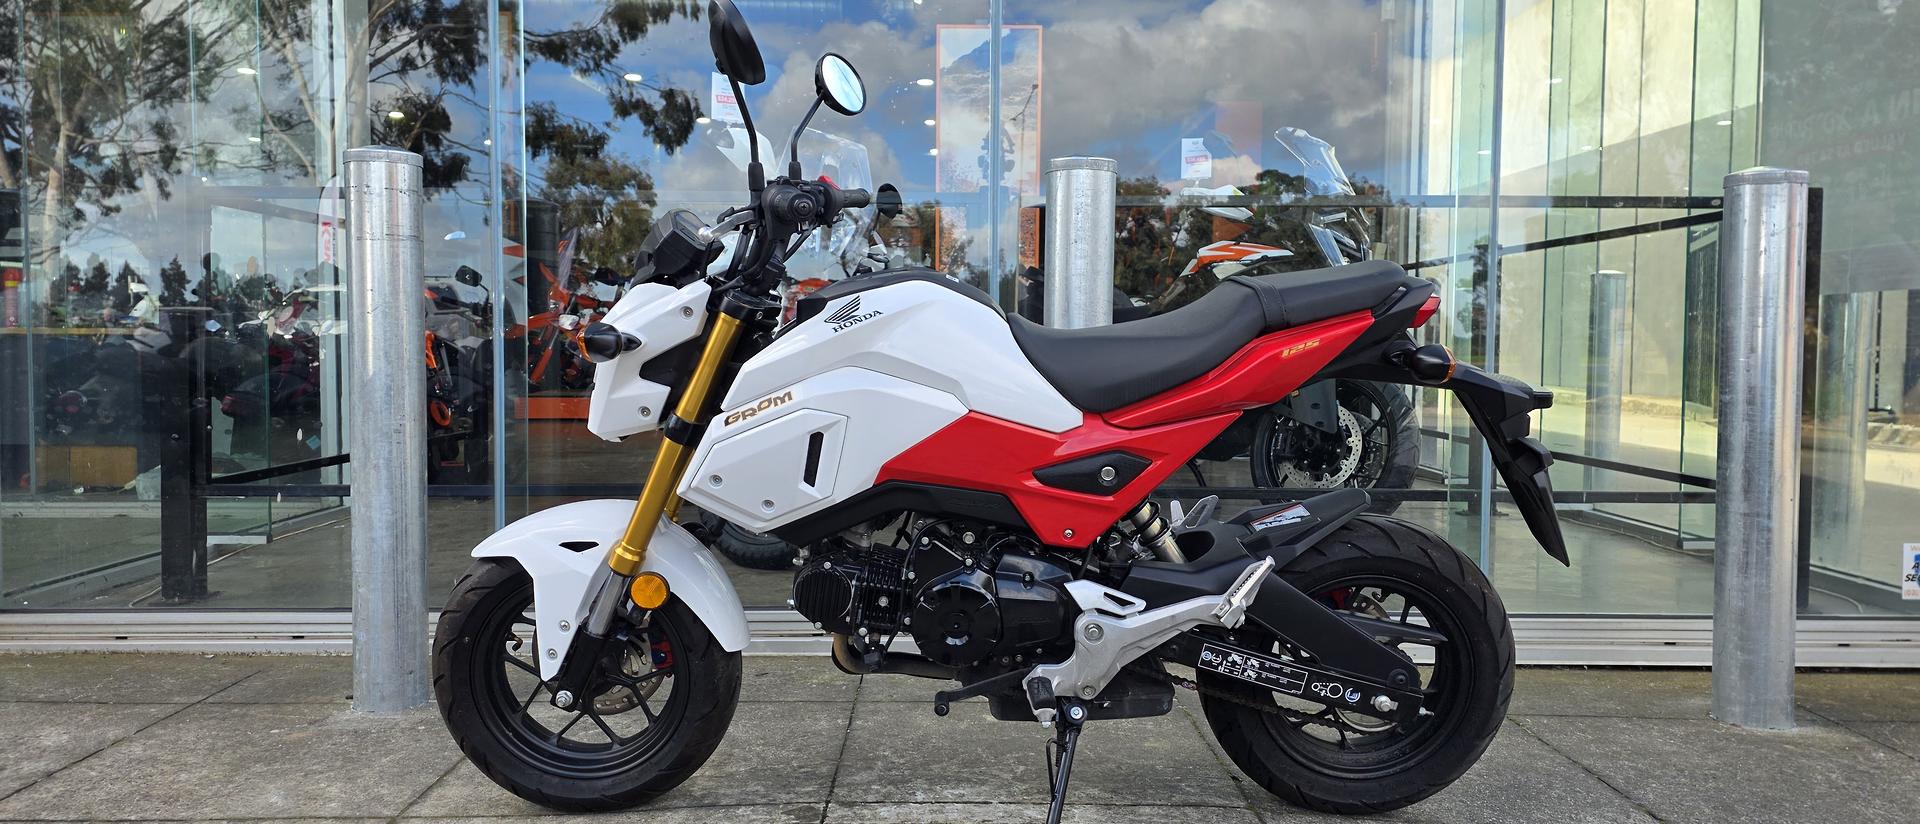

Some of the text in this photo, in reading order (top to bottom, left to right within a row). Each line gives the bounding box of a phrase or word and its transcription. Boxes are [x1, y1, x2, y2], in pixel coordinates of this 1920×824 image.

[832, 310, 883, 333] HONDA
[1281, 339, 1320, 358] 125
[724, 391, 793, 427] GROM
